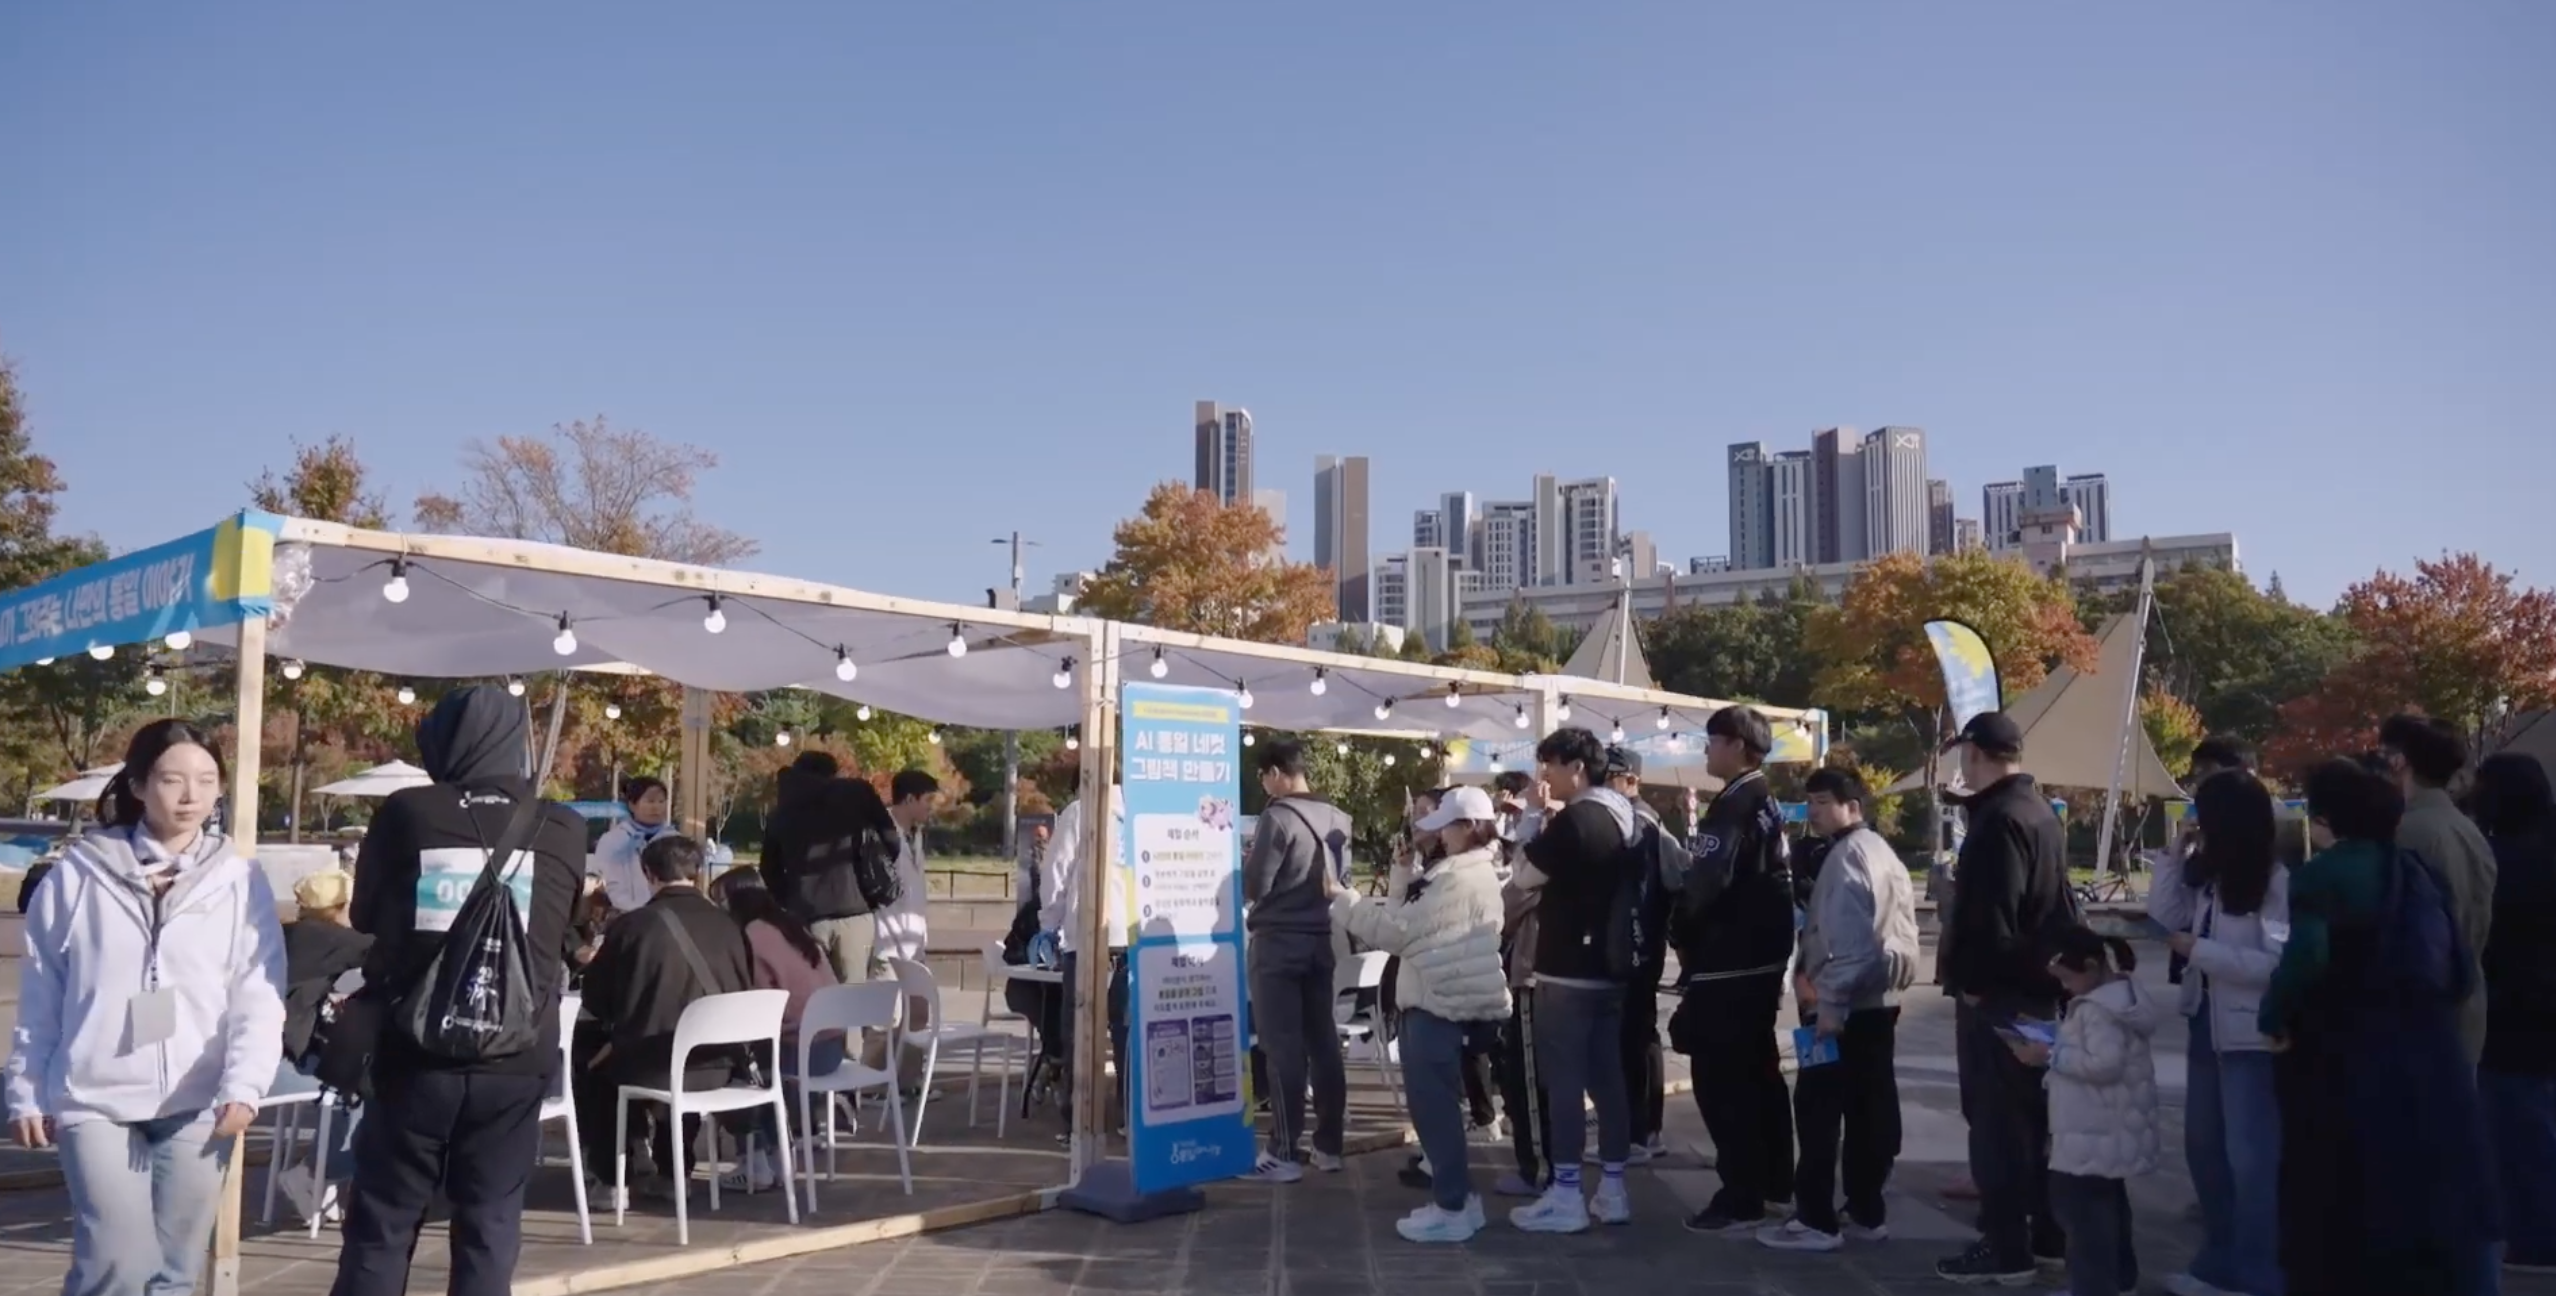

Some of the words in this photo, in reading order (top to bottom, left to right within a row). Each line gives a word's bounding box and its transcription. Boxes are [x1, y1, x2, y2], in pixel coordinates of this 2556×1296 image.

[66, 579, 108, 629] 나만의
[109, 568, 141, 622] 통일
[143, 553, 195, 609] 이야기
[1135, 730, 1153, 750] AI
[1157, 730, 1189, 754] 통일
[1130, 756, 1178, 781] 그림책
[1183, 760, 1231, 783] 만들기
